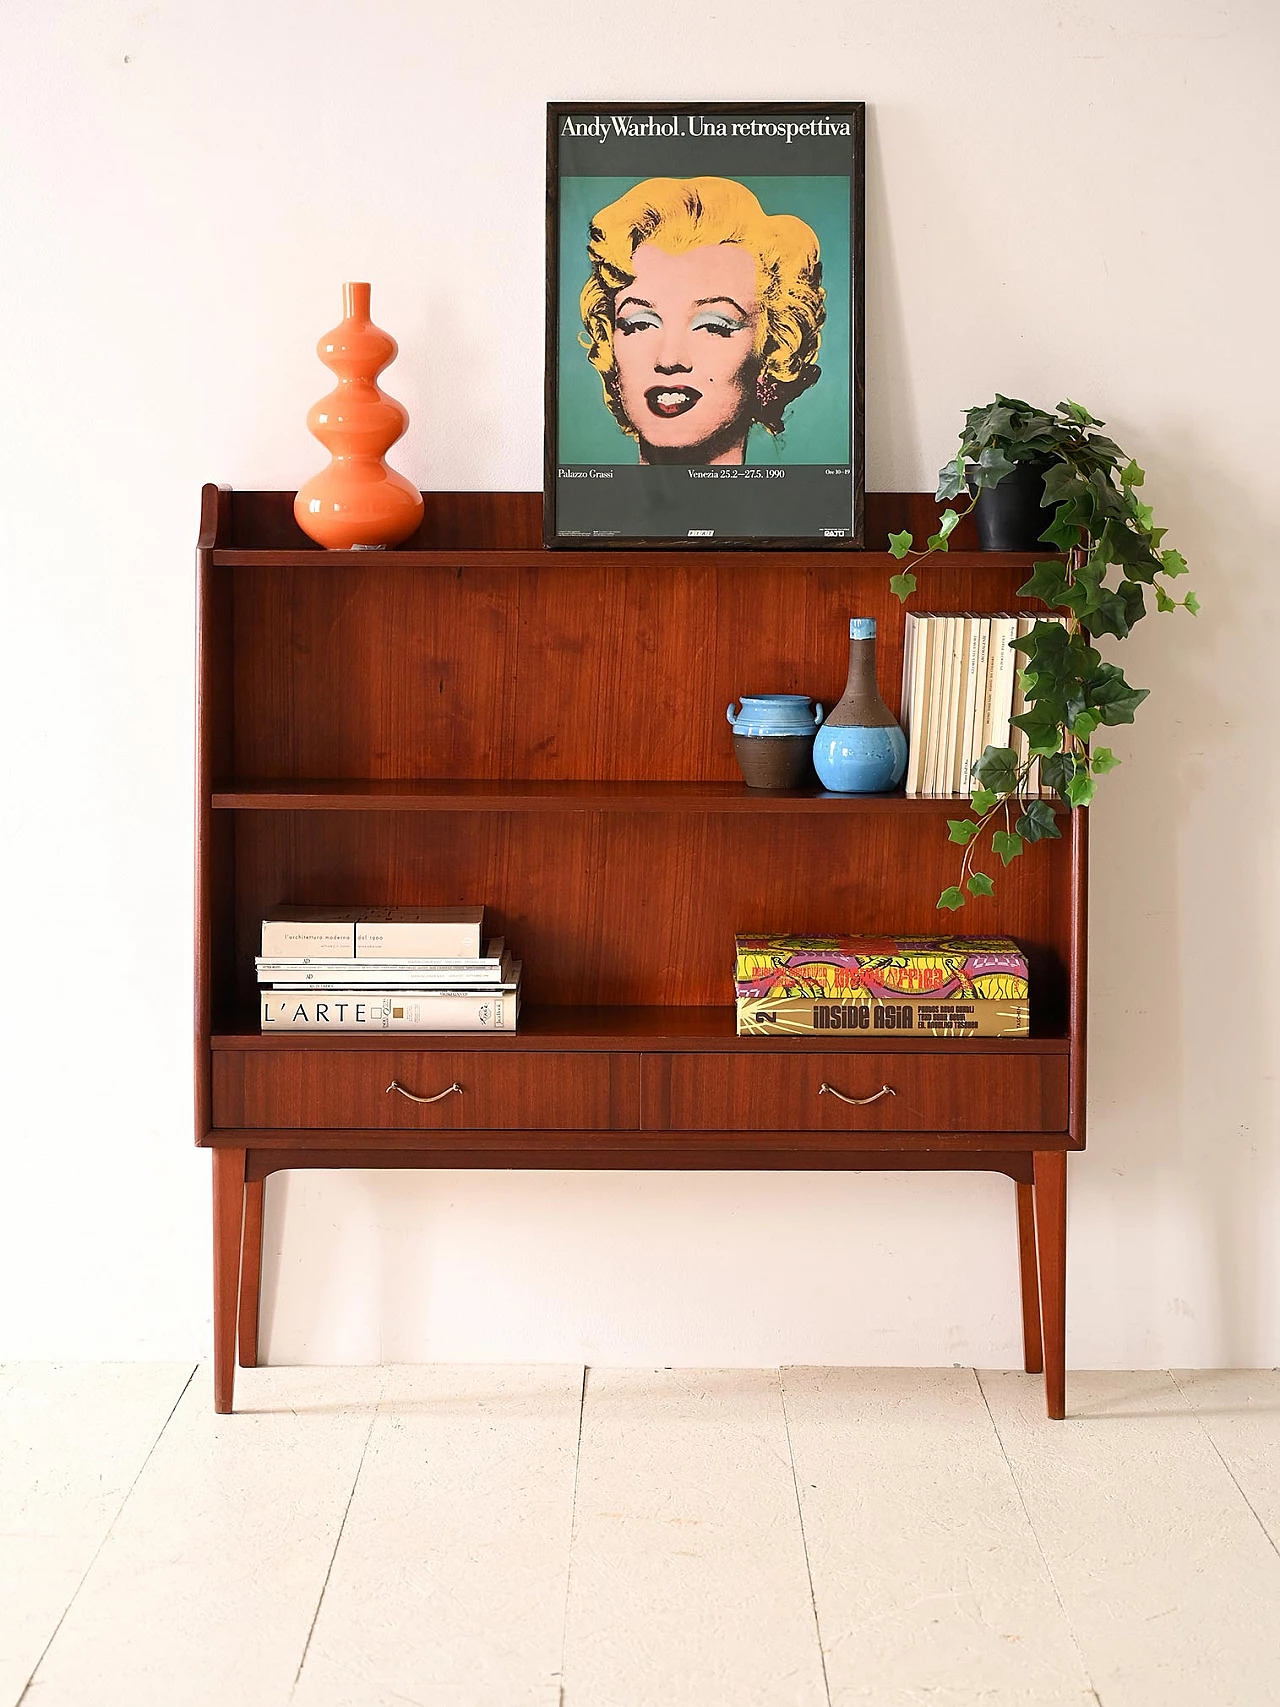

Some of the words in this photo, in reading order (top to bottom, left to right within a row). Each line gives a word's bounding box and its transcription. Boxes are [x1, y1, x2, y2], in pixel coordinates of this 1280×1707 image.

[561, 116, 611, 143] Andy
[610, 116, 685, 137] Warhol.
[688, 116, 727, 137] Una
[731, 116, 851, 143] retrospettiva
[558, 469, 588, 478] Palazzo
[589, 469, 613, 478] Grassi
[688, 470, 718, 478] Venezia
[765, 469, 785, 478] 1990
[265, 1003, 366, 1022] L'ARTE
